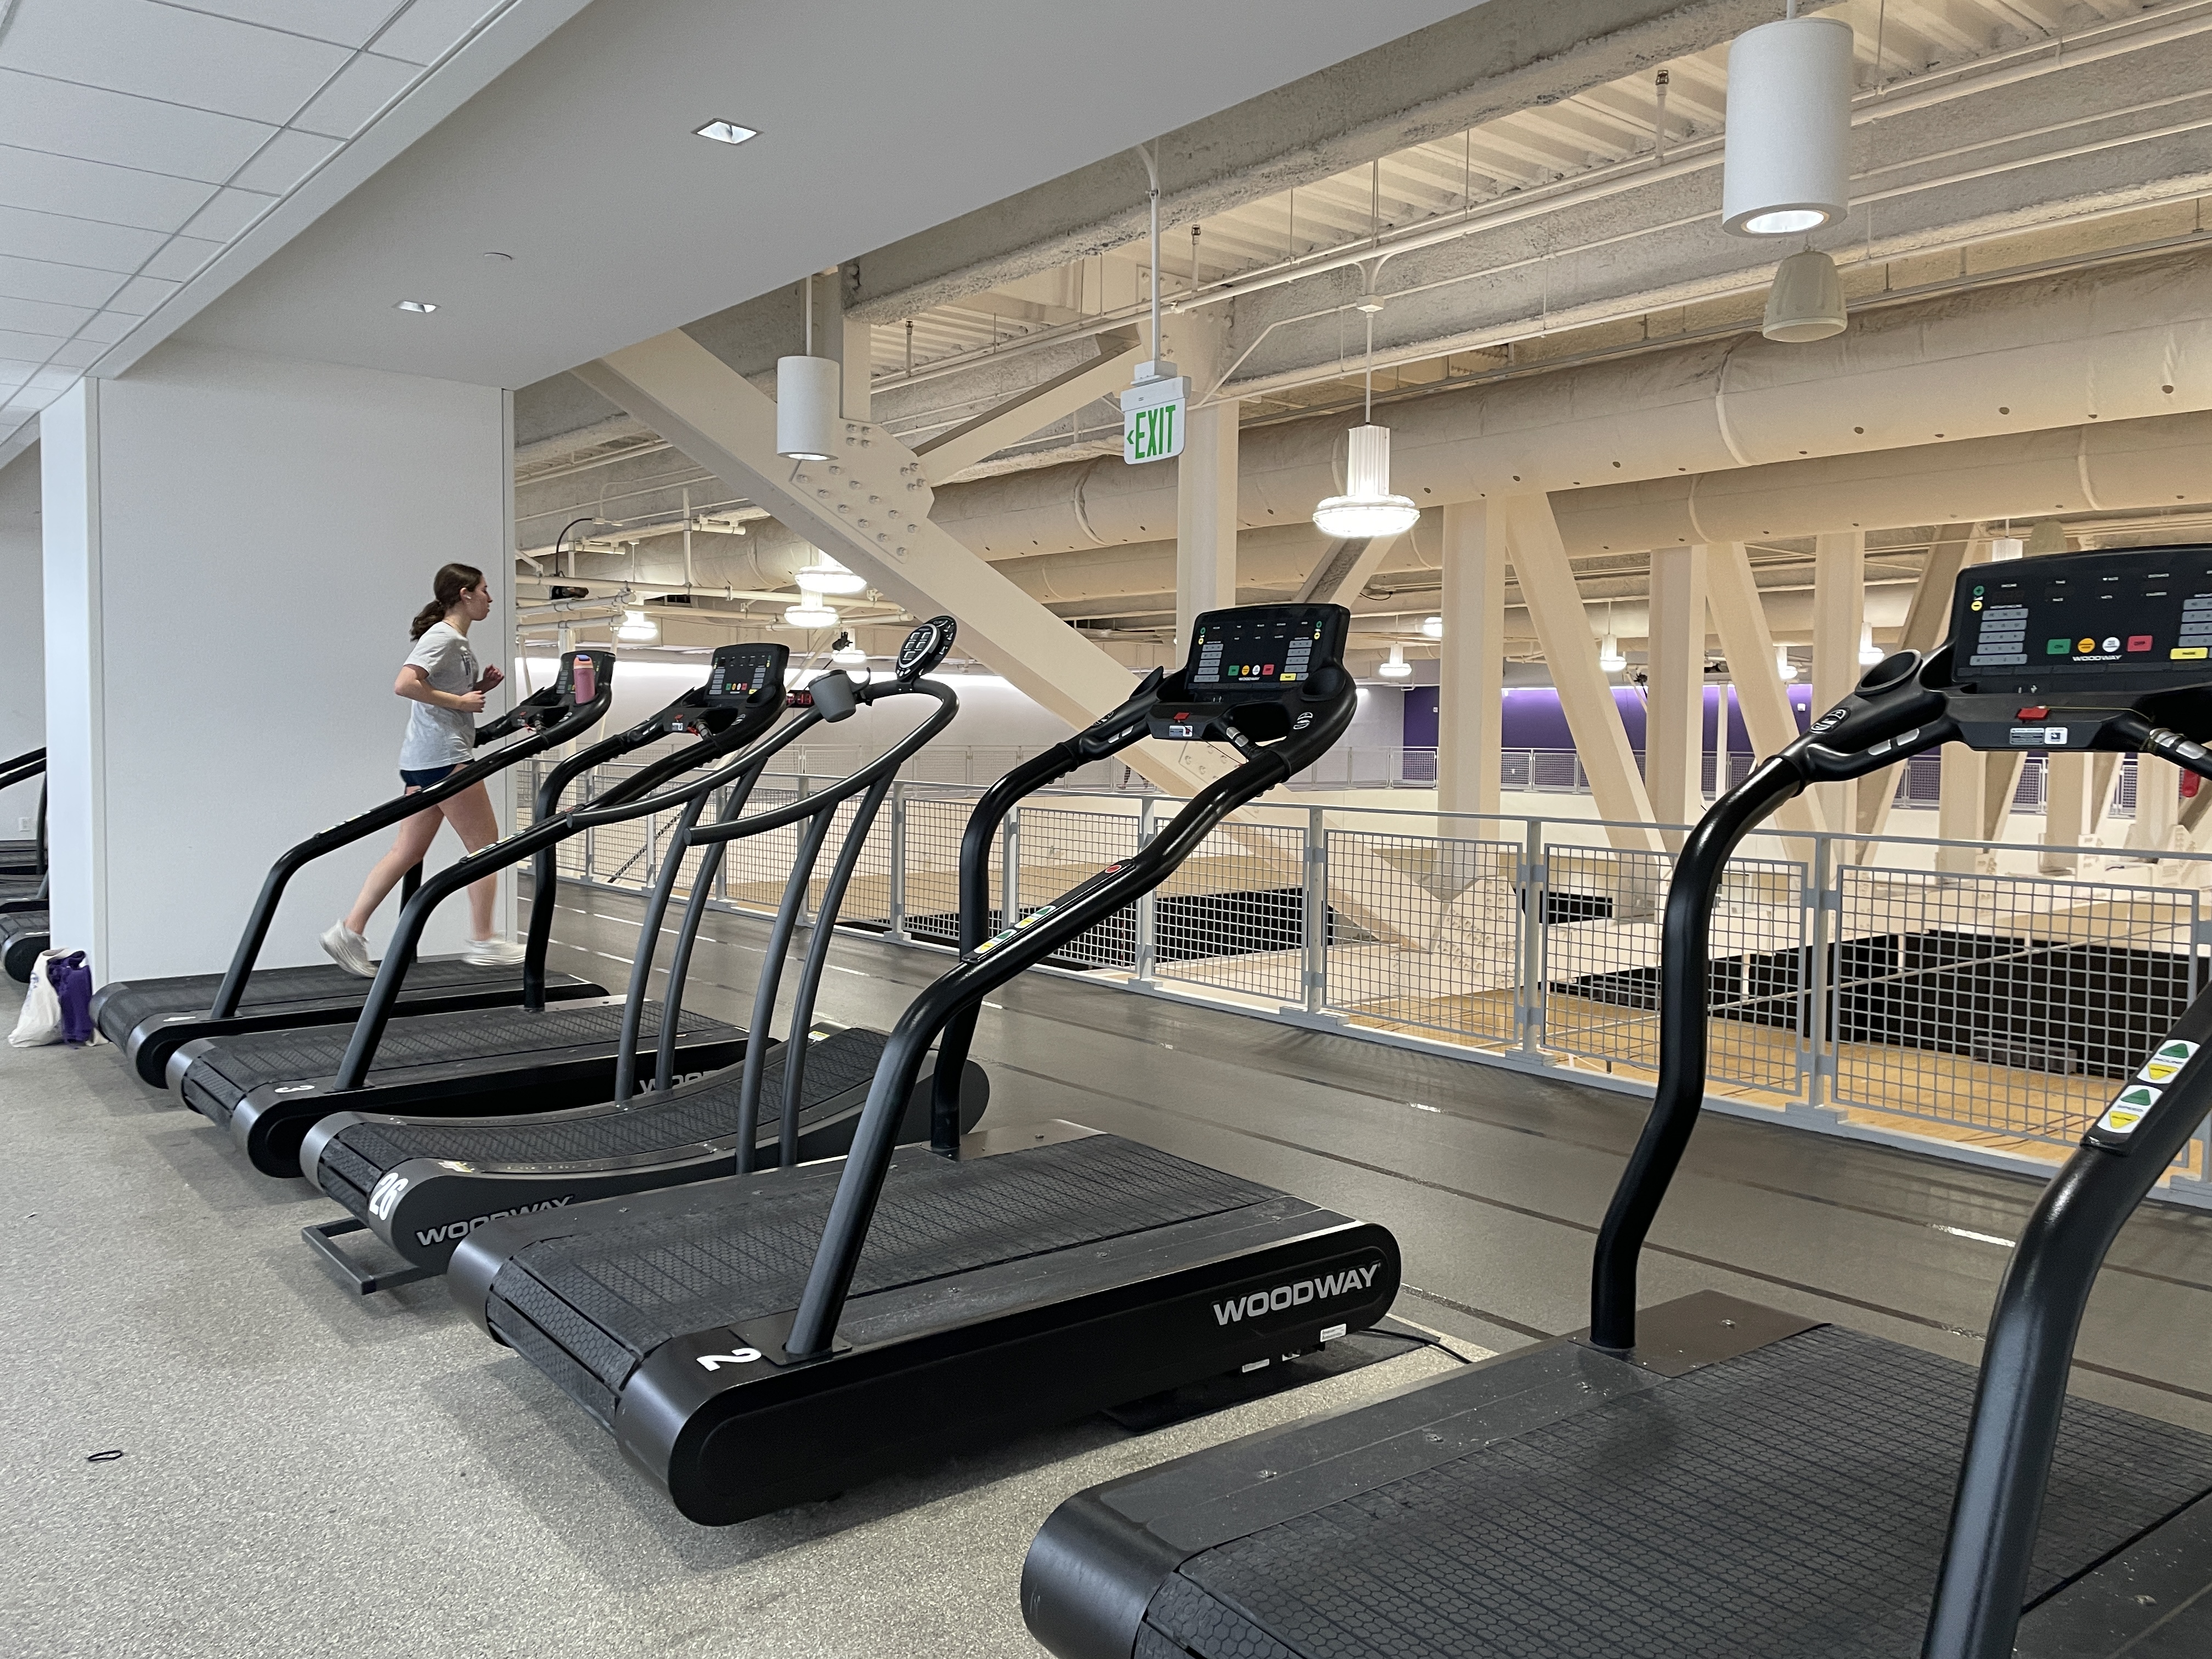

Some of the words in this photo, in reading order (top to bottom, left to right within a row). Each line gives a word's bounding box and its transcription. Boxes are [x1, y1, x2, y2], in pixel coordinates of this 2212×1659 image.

[1135, 405, 1176, 459] EXIT
[369, 1172, 409, 1221] 26
[1213, 1264, 1379, 1325] WOODWAY
[696, 1347, 761, 1372] 2
